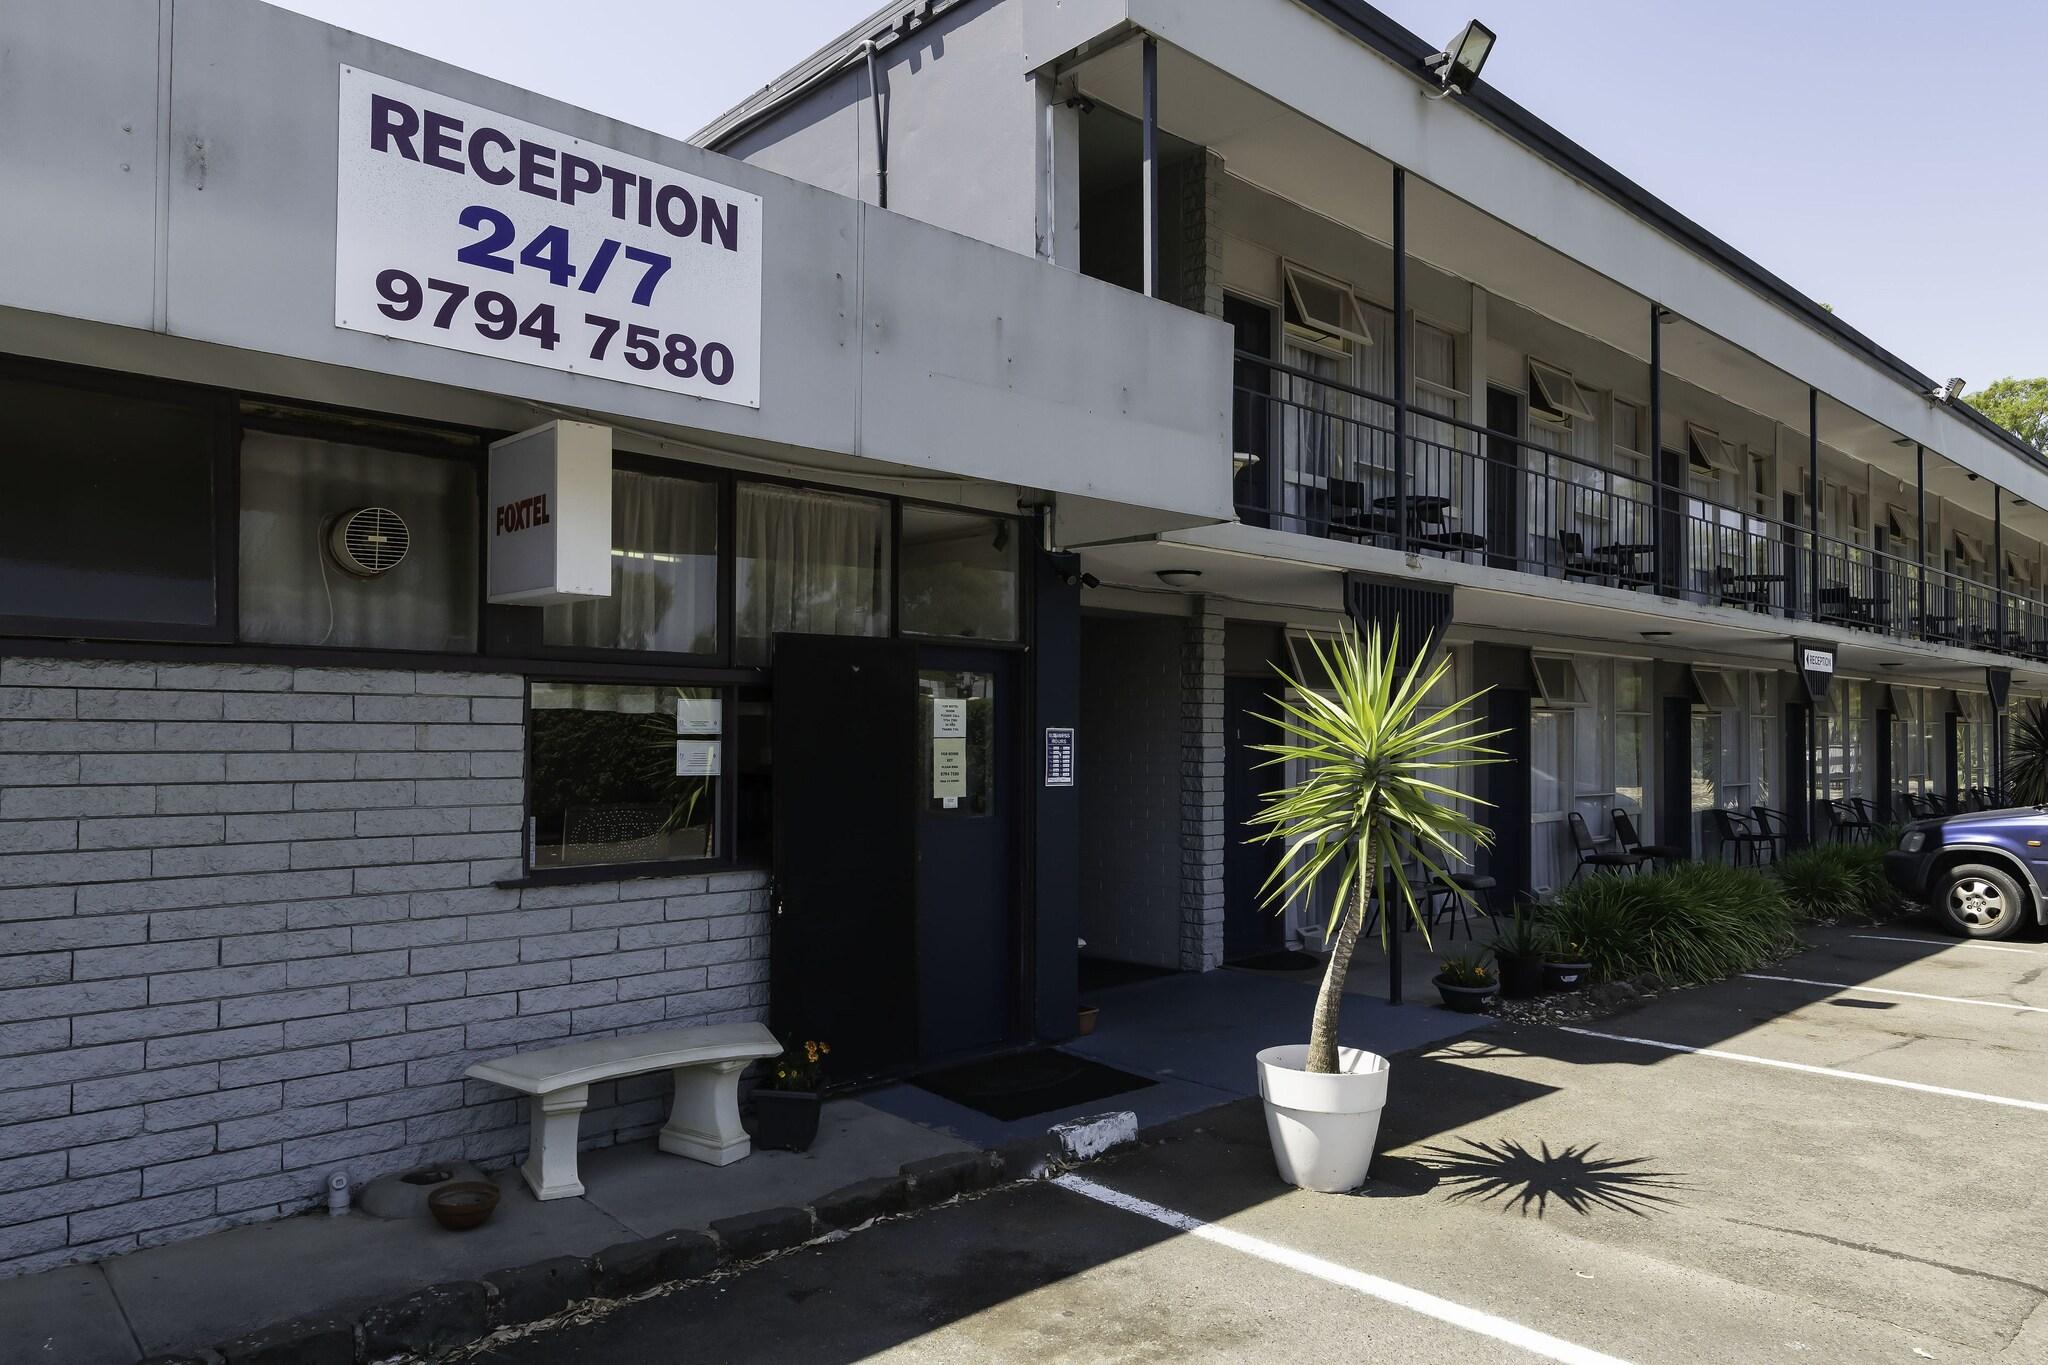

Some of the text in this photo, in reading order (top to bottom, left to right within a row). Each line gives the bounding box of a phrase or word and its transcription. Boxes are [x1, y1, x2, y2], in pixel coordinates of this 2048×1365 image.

[371, 93, 738, 252] RECEPTION
[457, 205, 671, 307] 24/7
[375, 269, 734, 386] 9794 7580
[496, 493, 550, 537] FOXTEL
